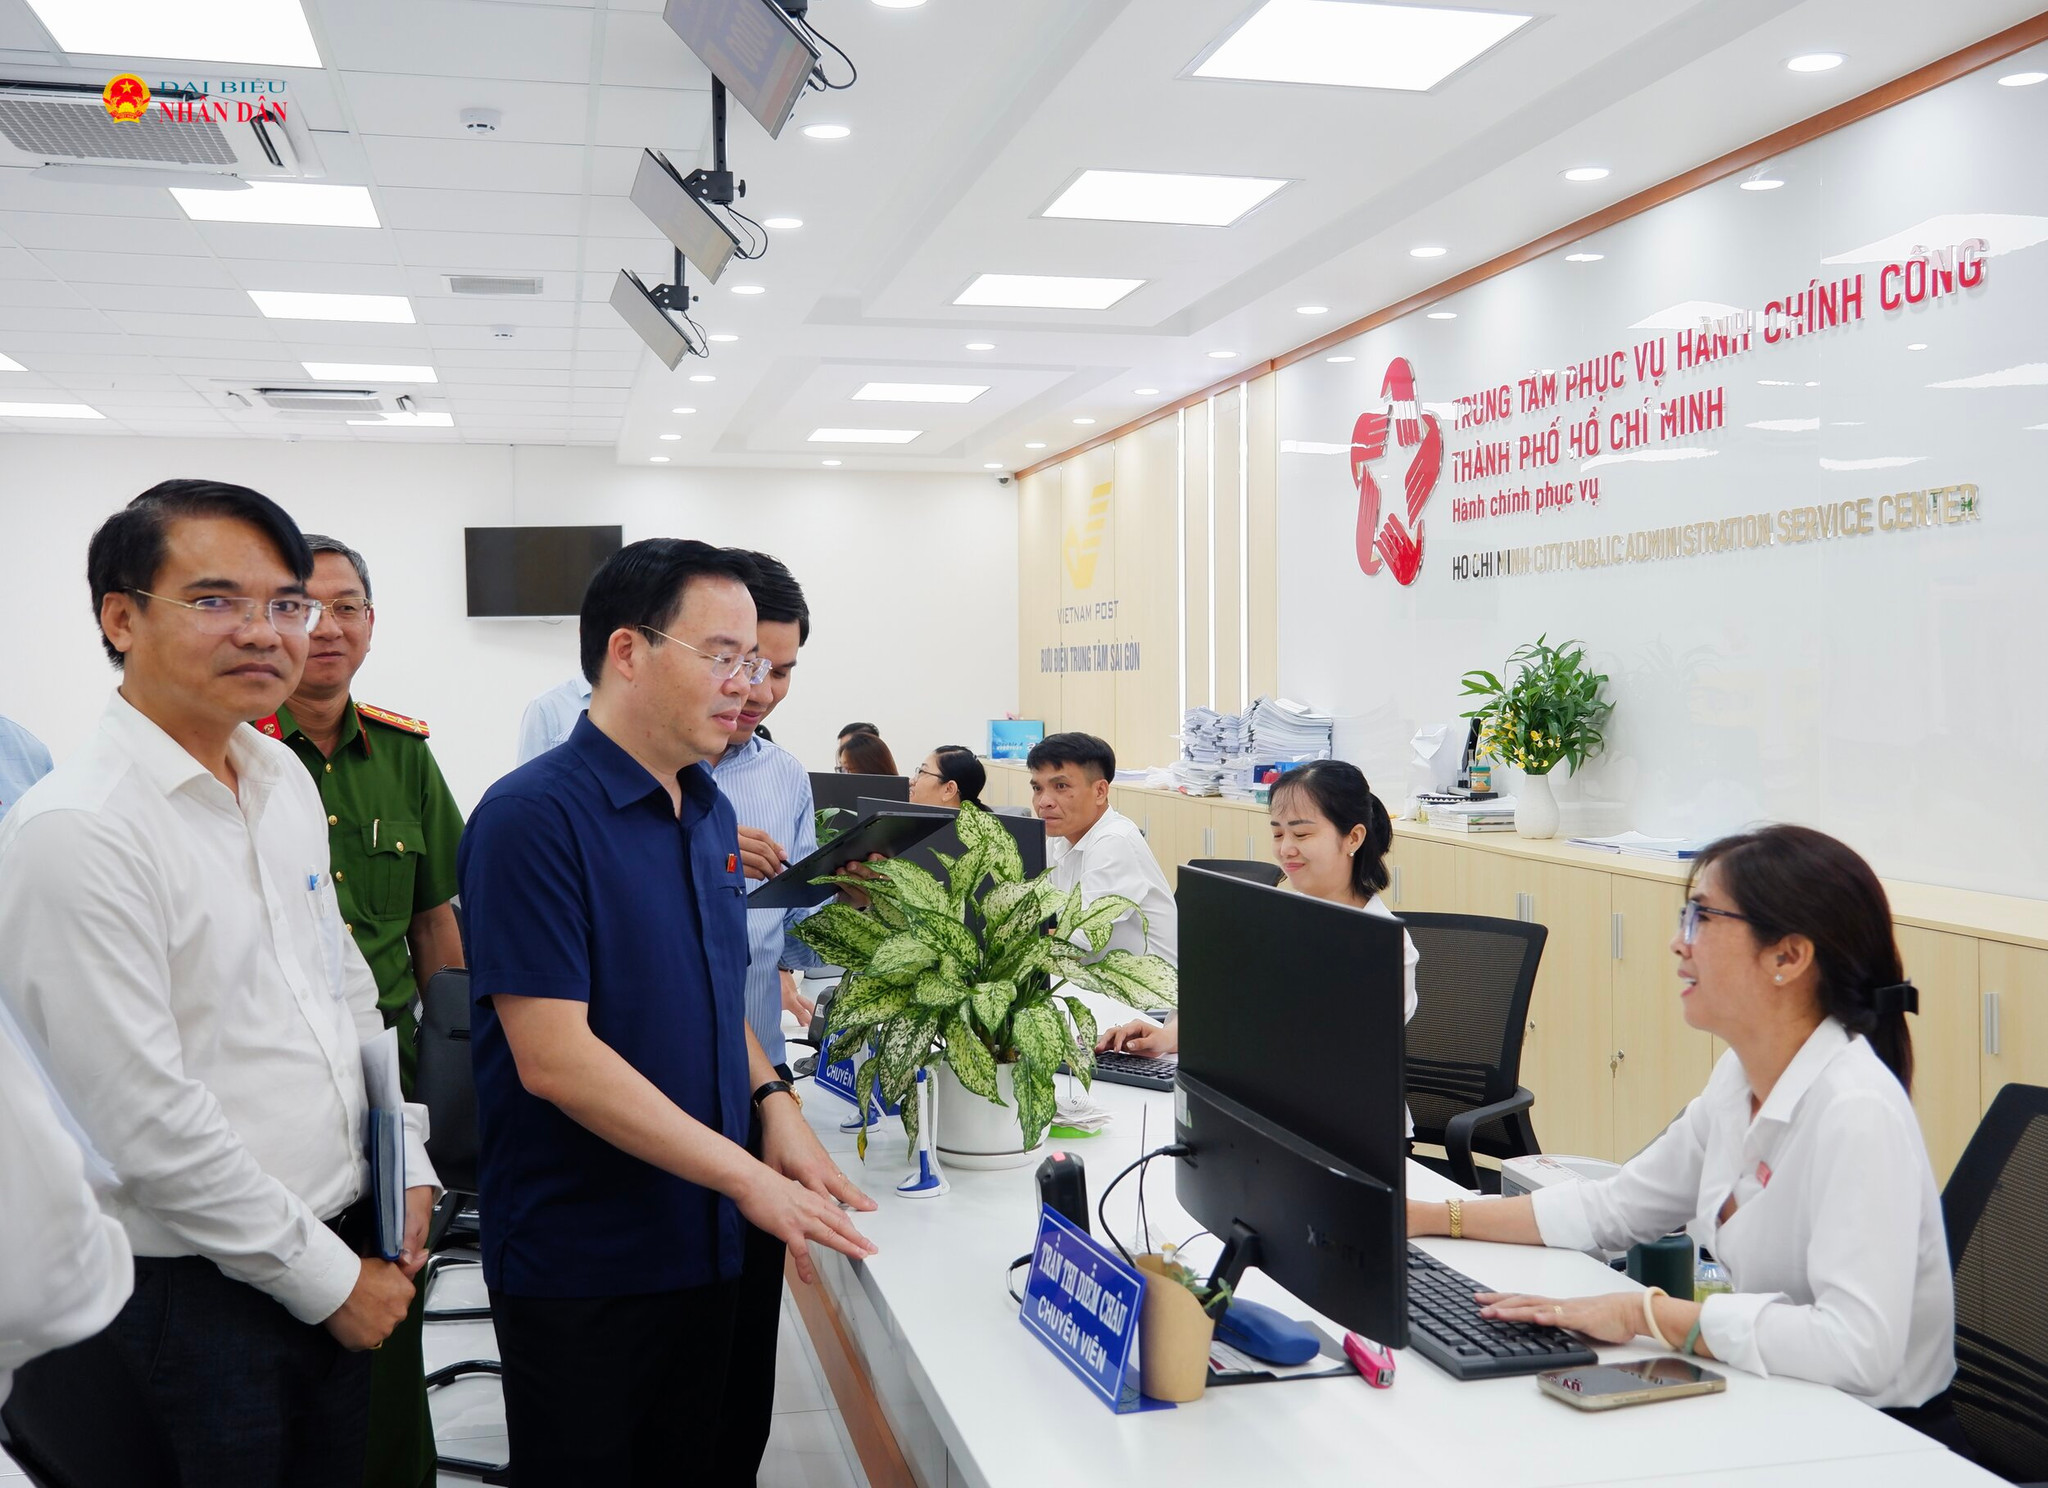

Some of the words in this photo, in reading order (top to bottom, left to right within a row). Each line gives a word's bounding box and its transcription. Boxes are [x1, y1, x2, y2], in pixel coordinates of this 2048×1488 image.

[1452, 384, 1512, 431] TRUNG
[1518, 369, 1558, 413] TÂM
[1565, 350, 1627, 402] PHỤC
[1634, 336, 1668, 387] VỤ
[1677, 310, 1752, 371] HÀNH
[1764, 274, 1864, 344] CHÍNH
[1880, 238, 1988, 312] CÔNG
[1452, 440, 1511, 484] THÀNH
[1519, 415, 1561, 470] PHỐ
[1569, 406, 1600, 459] HỒ
[1610, 396, 1651, 450] CHÍ
[1660, 386, 1727, 441] MINH
[1452, 494, 1485, 523] Hành
[1490, 486, 1530, 517] chính
[1536, 481, 1574, 516] phục
[1579, 477, 1600, 506] vụ
[1452, 554, 1469, 581] HO
[1472, 551, 1493, 578] CHI
[1497, 547, 1531, 576] MINH
[1533, 542, 1564, 572] CITY
[1566, 534, 1625, 570] PUBLIC
[1625, 512, 1774, 562] ADMINISTRATION
[1777, 498, 1873, 544] SERVICE
[1878, 483, 1981, 532] CENTER
[1057, 604, 1092, 624] VIETNAM
[1095, 600, 1119, 620] POST
[1070, 645, 1091, 672] TRUNG
[1093, 639, 1108, 671] TÂM
[1110, 637, 1122, 671] SÀI
[1124, 635, 1140, 671] GÒN
[826, 1064, 854, 1089] CHUYÊN
[1038, 1233, 1064, 1283] TRẦN
[1060, 1260, 1080, 1304] THỊ
[1099, 1290, 1128, 1337] CHÂU
[1037, 1295, 1080, 1349] CHUYÊN
[1079, 1336, 1108, 1374] VIÊN
